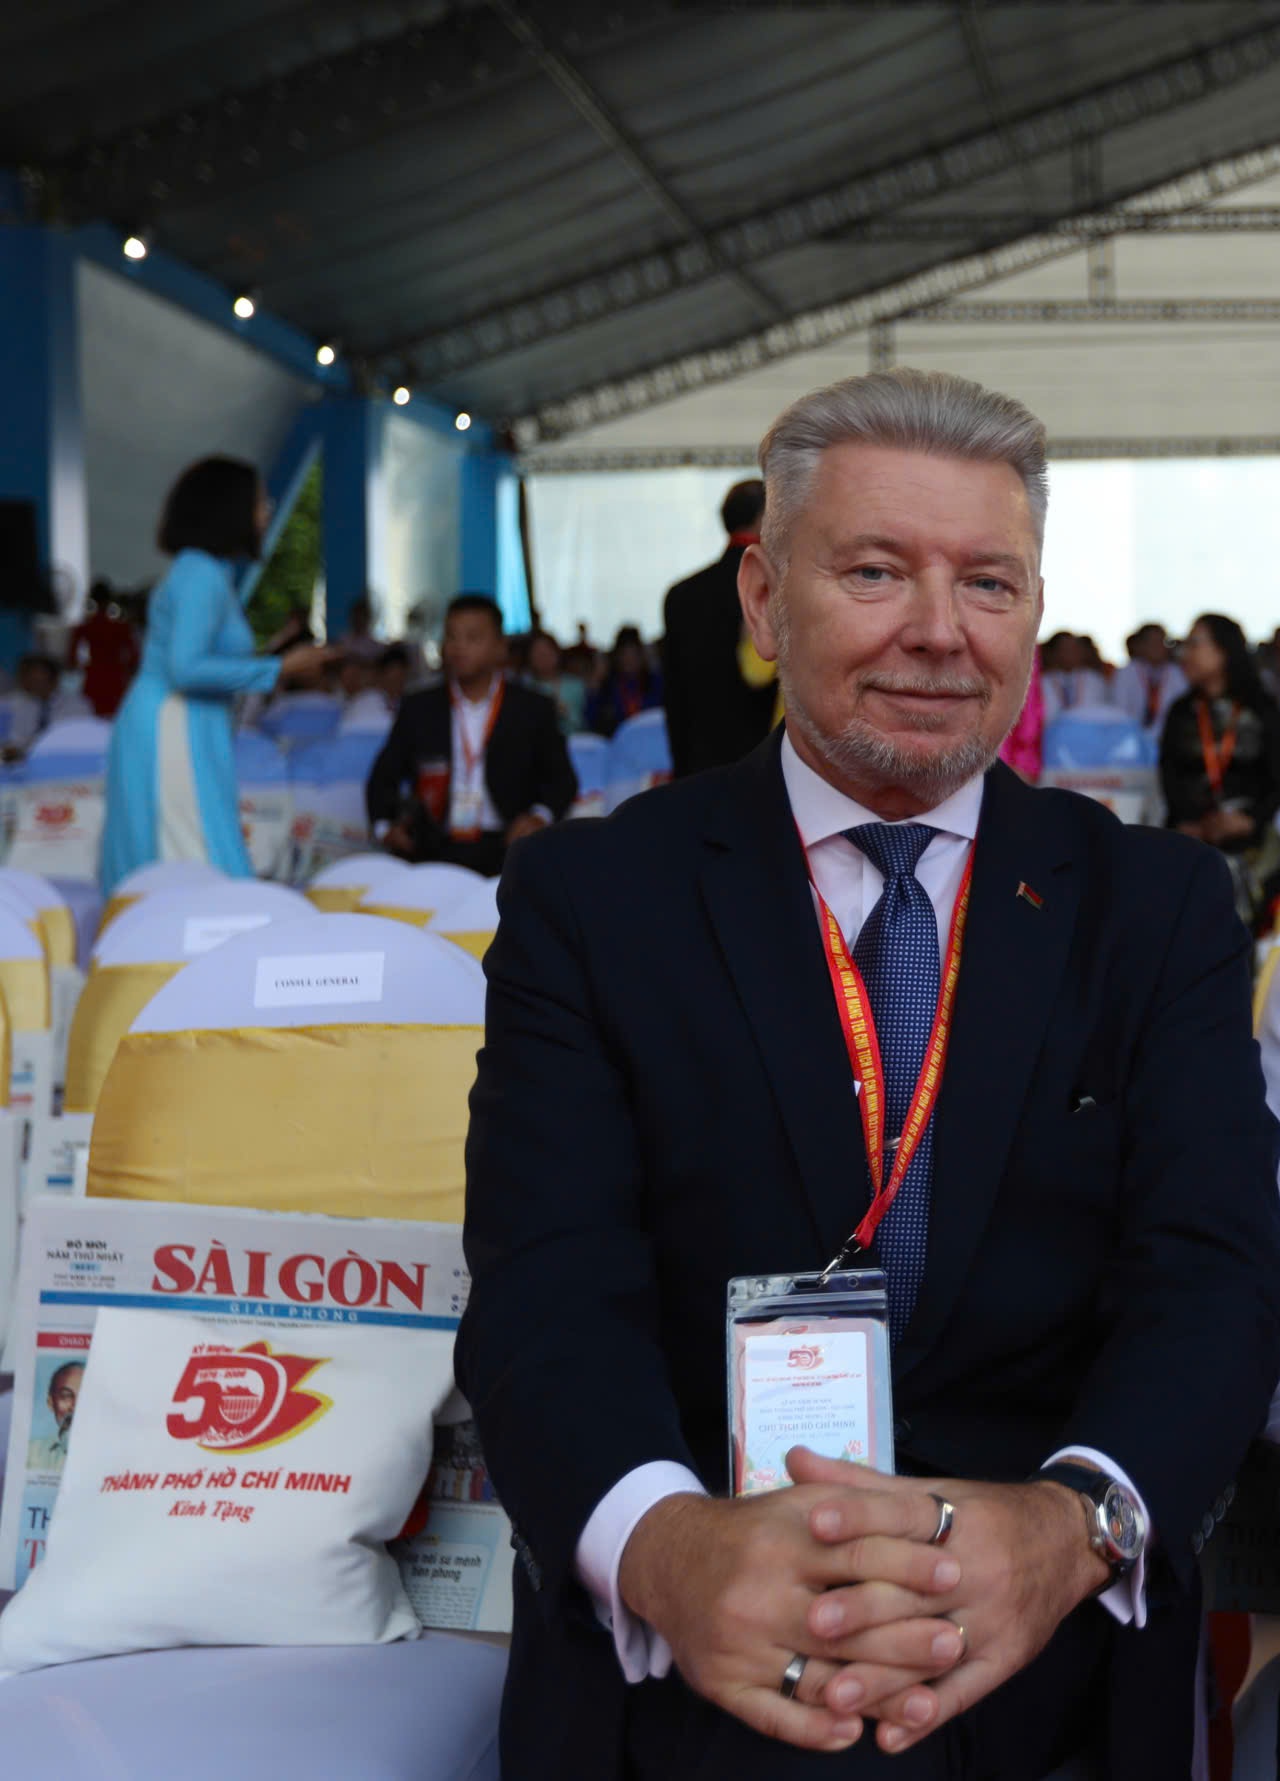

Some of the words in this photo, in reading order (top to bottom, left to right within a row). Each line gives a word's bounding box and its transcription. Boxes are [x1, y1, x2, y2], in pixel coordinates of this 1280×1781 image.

[152, 1239, 272, 1299] SÀI
[278, 1249, 431, 1312] GÒN
[166, 1354, 284, 1448] 50
[100, 1470, 159, 1493] THÀNH
[162, 1466, 209, 1490] PHỐ
[206, 1466, 236, 1489] HỒ
[240, 1466, 285, 1489] CHÍ
[284, 1471, 352, 1494] MINH
[168, 1500, 205, 1517] Kính
[211, 1500, 254, 1522] Tặng
